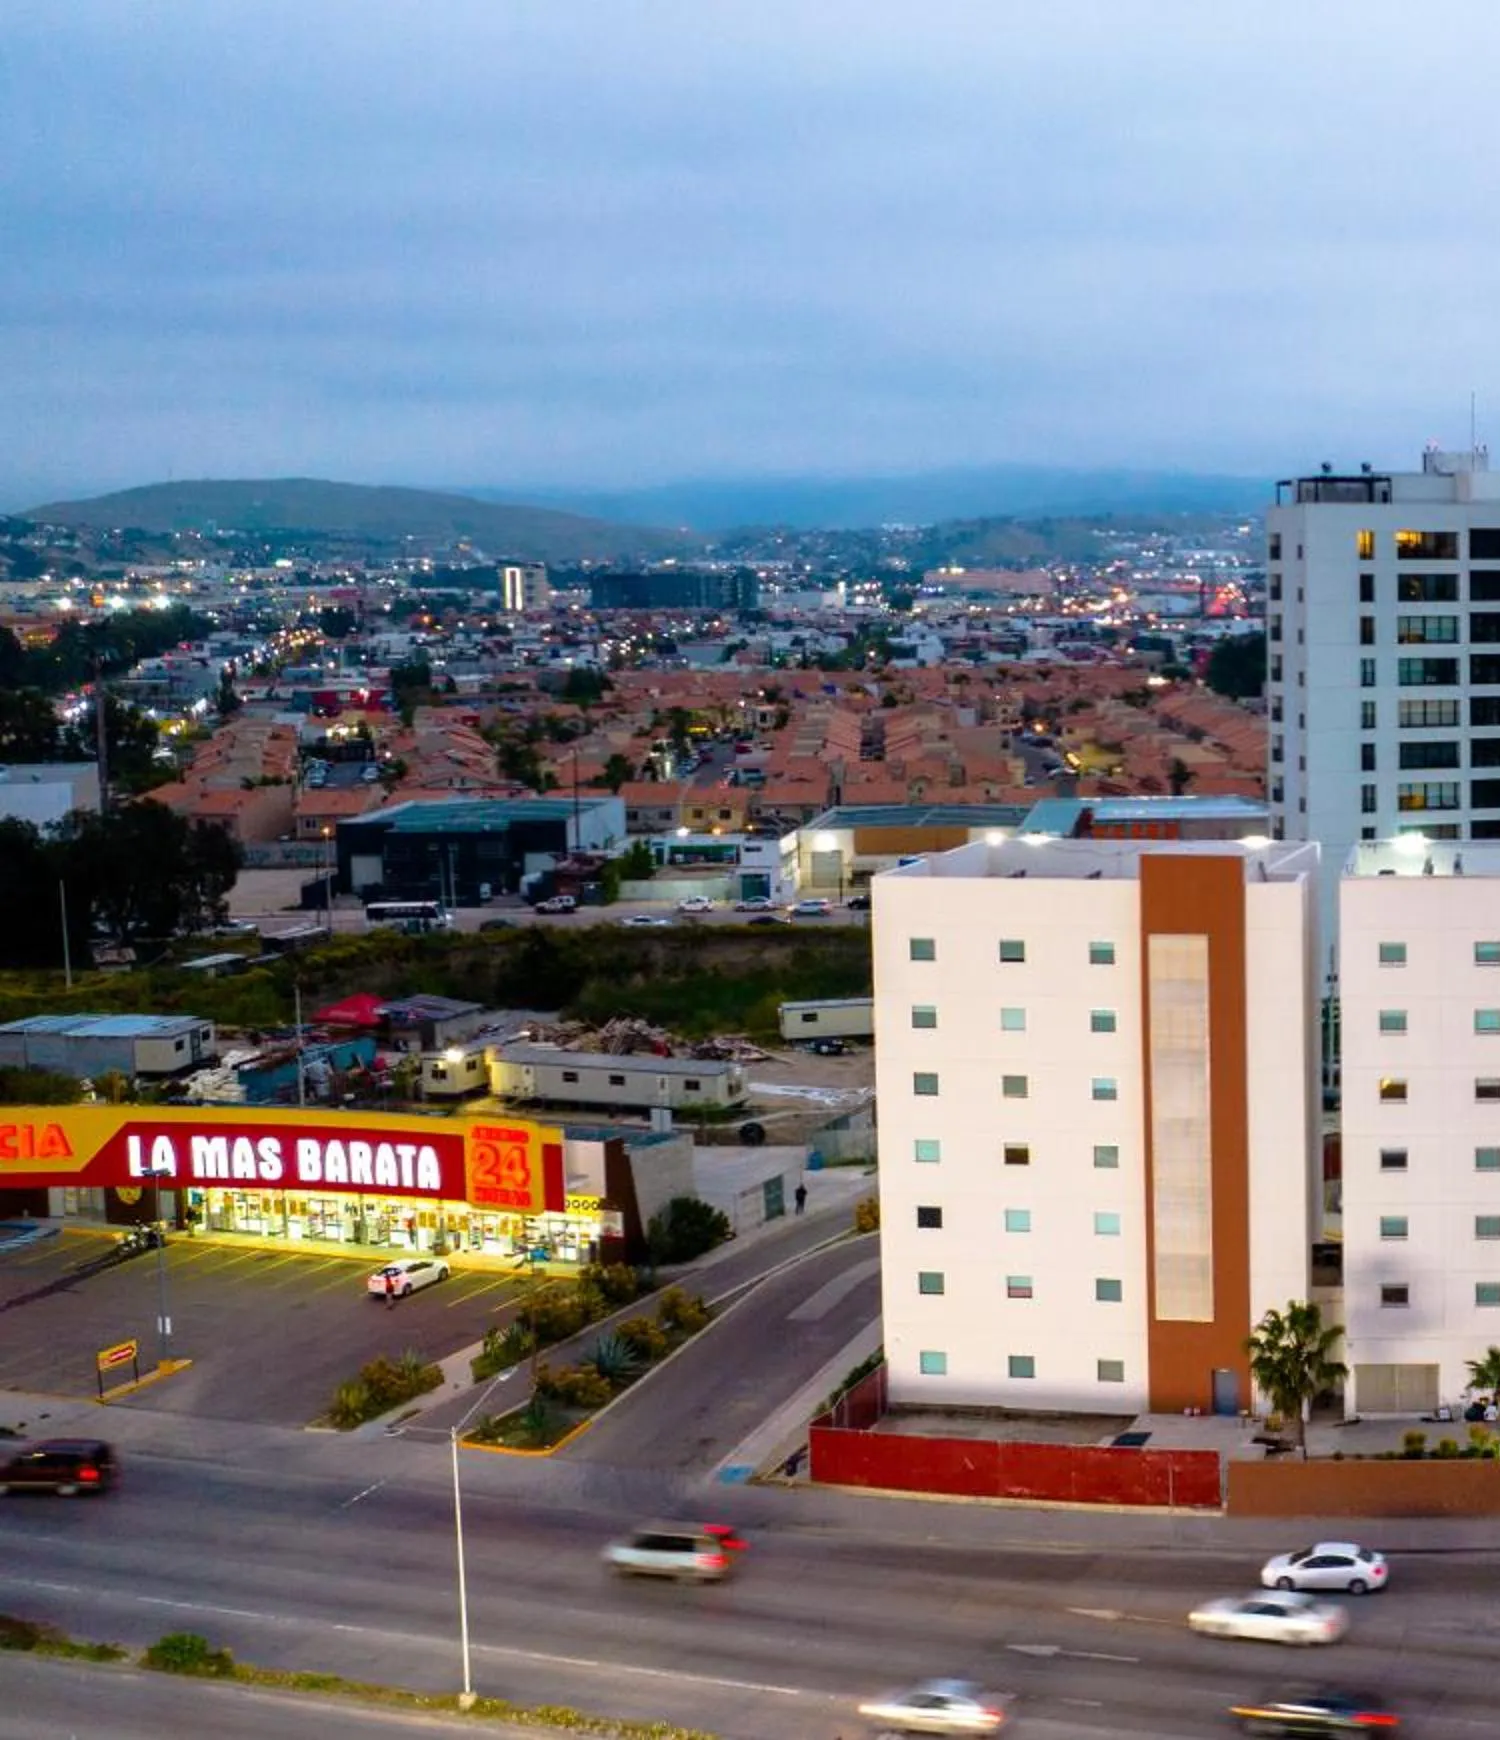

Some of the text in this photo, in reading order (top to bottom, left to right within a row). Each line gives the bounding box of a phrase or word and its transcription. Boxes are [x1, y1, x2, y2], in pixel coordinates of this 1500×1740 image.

[0, 1123, 74, 1158] CIA
[127, 1134, 441, 1190] LA MAS BARATA
[472, 1143, 531, 1187] 24
